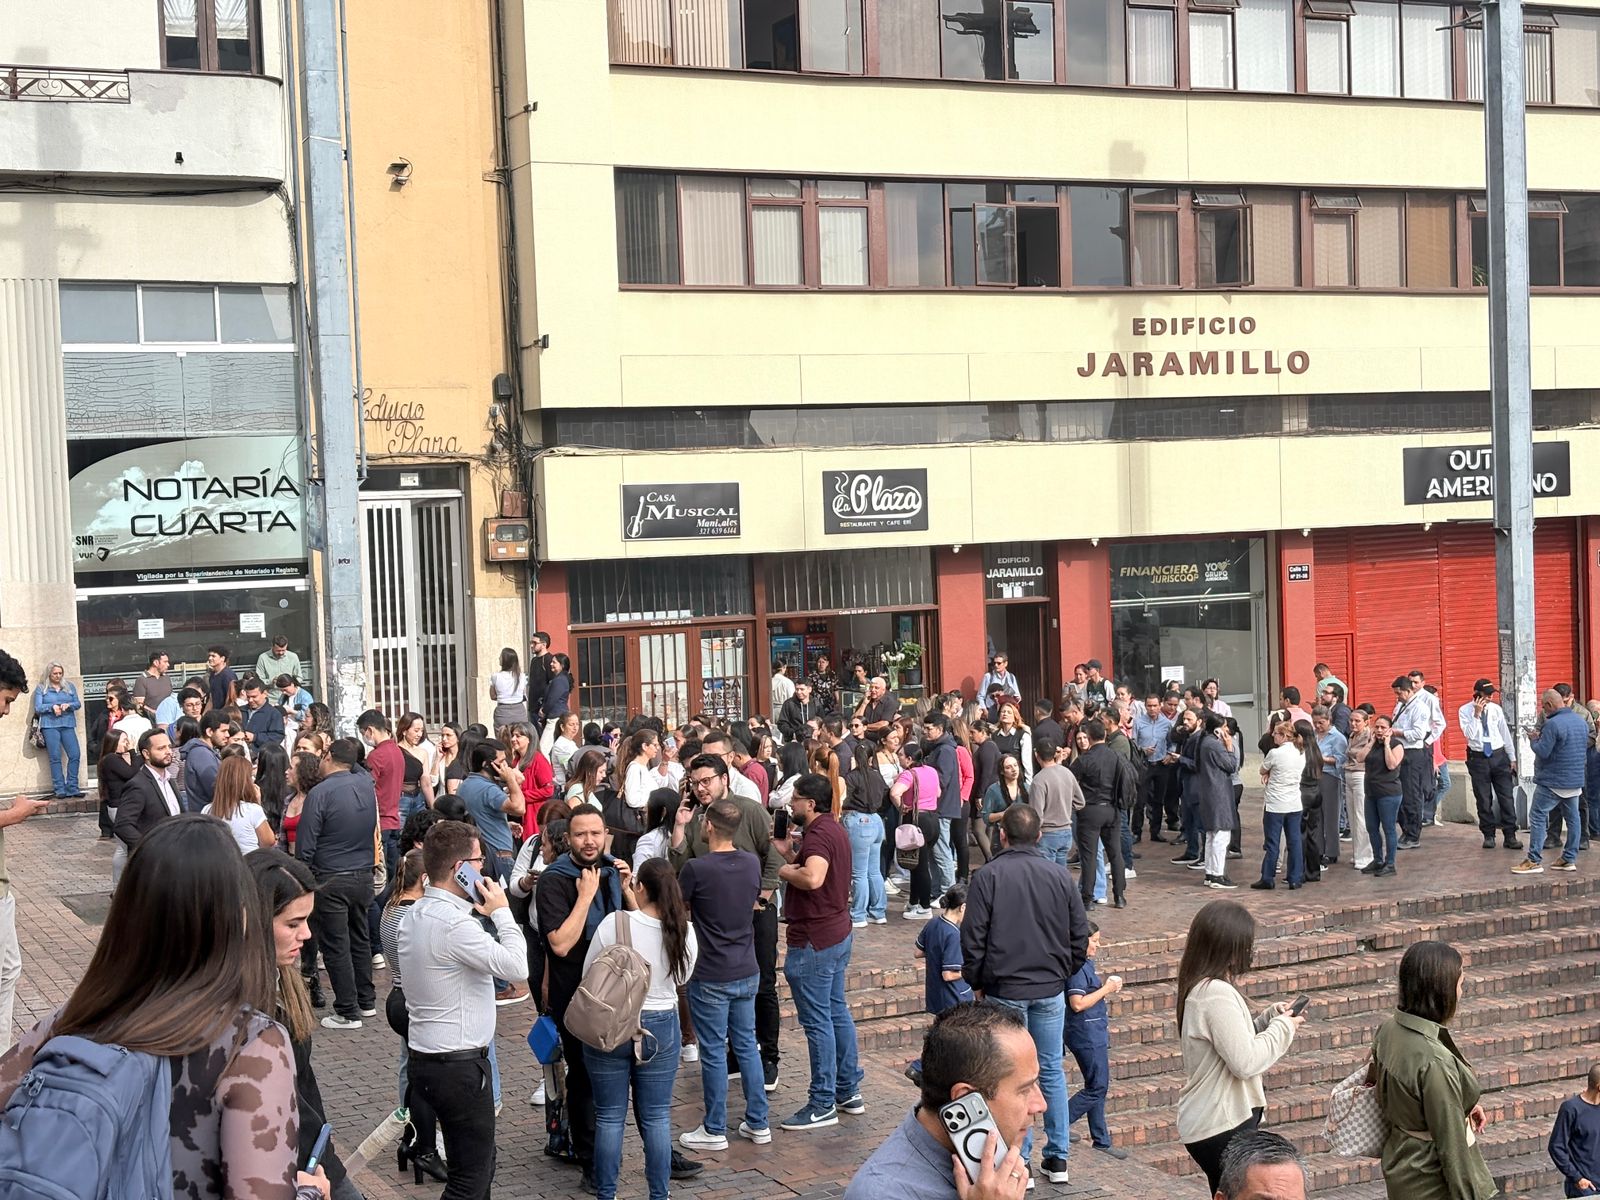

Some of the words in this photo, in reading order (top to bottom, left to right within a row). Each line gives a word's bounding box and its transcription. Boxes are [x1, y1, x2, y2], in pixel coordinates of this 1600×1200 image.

[1133, 316, 1257, 336] EDIFICIO
[1077, 350, 1310, 378] JARAMILLO
[1449, 449, 1493, 471] OUT
[123, 467, 300, 502] NOTARÍA
[1426, 472, 1557, 498] AMERINO
[850, 474, 917, 514] Plaza
[131, 510, 297, 537] CUARTA
[75, 535, 94, 546] SNR
[997, 556, 1030, 564] EDIFICIO
[1205, 562, 1217, 571] YO
[136, 572, 163, 580] Vigilada
[185, 569, 233, 578] Superintendencia
[244, 567, 270, 575] Notariado
[276, 566, 299, 575] Registro
[986, 566, 1044, 578] JARAMILLO
[1120, 564, 1198, 577] FINANCIERA
[1205, 570, 1228, 578] GRUPO
[1150, 574, 1199, 584] JURISCOOP
